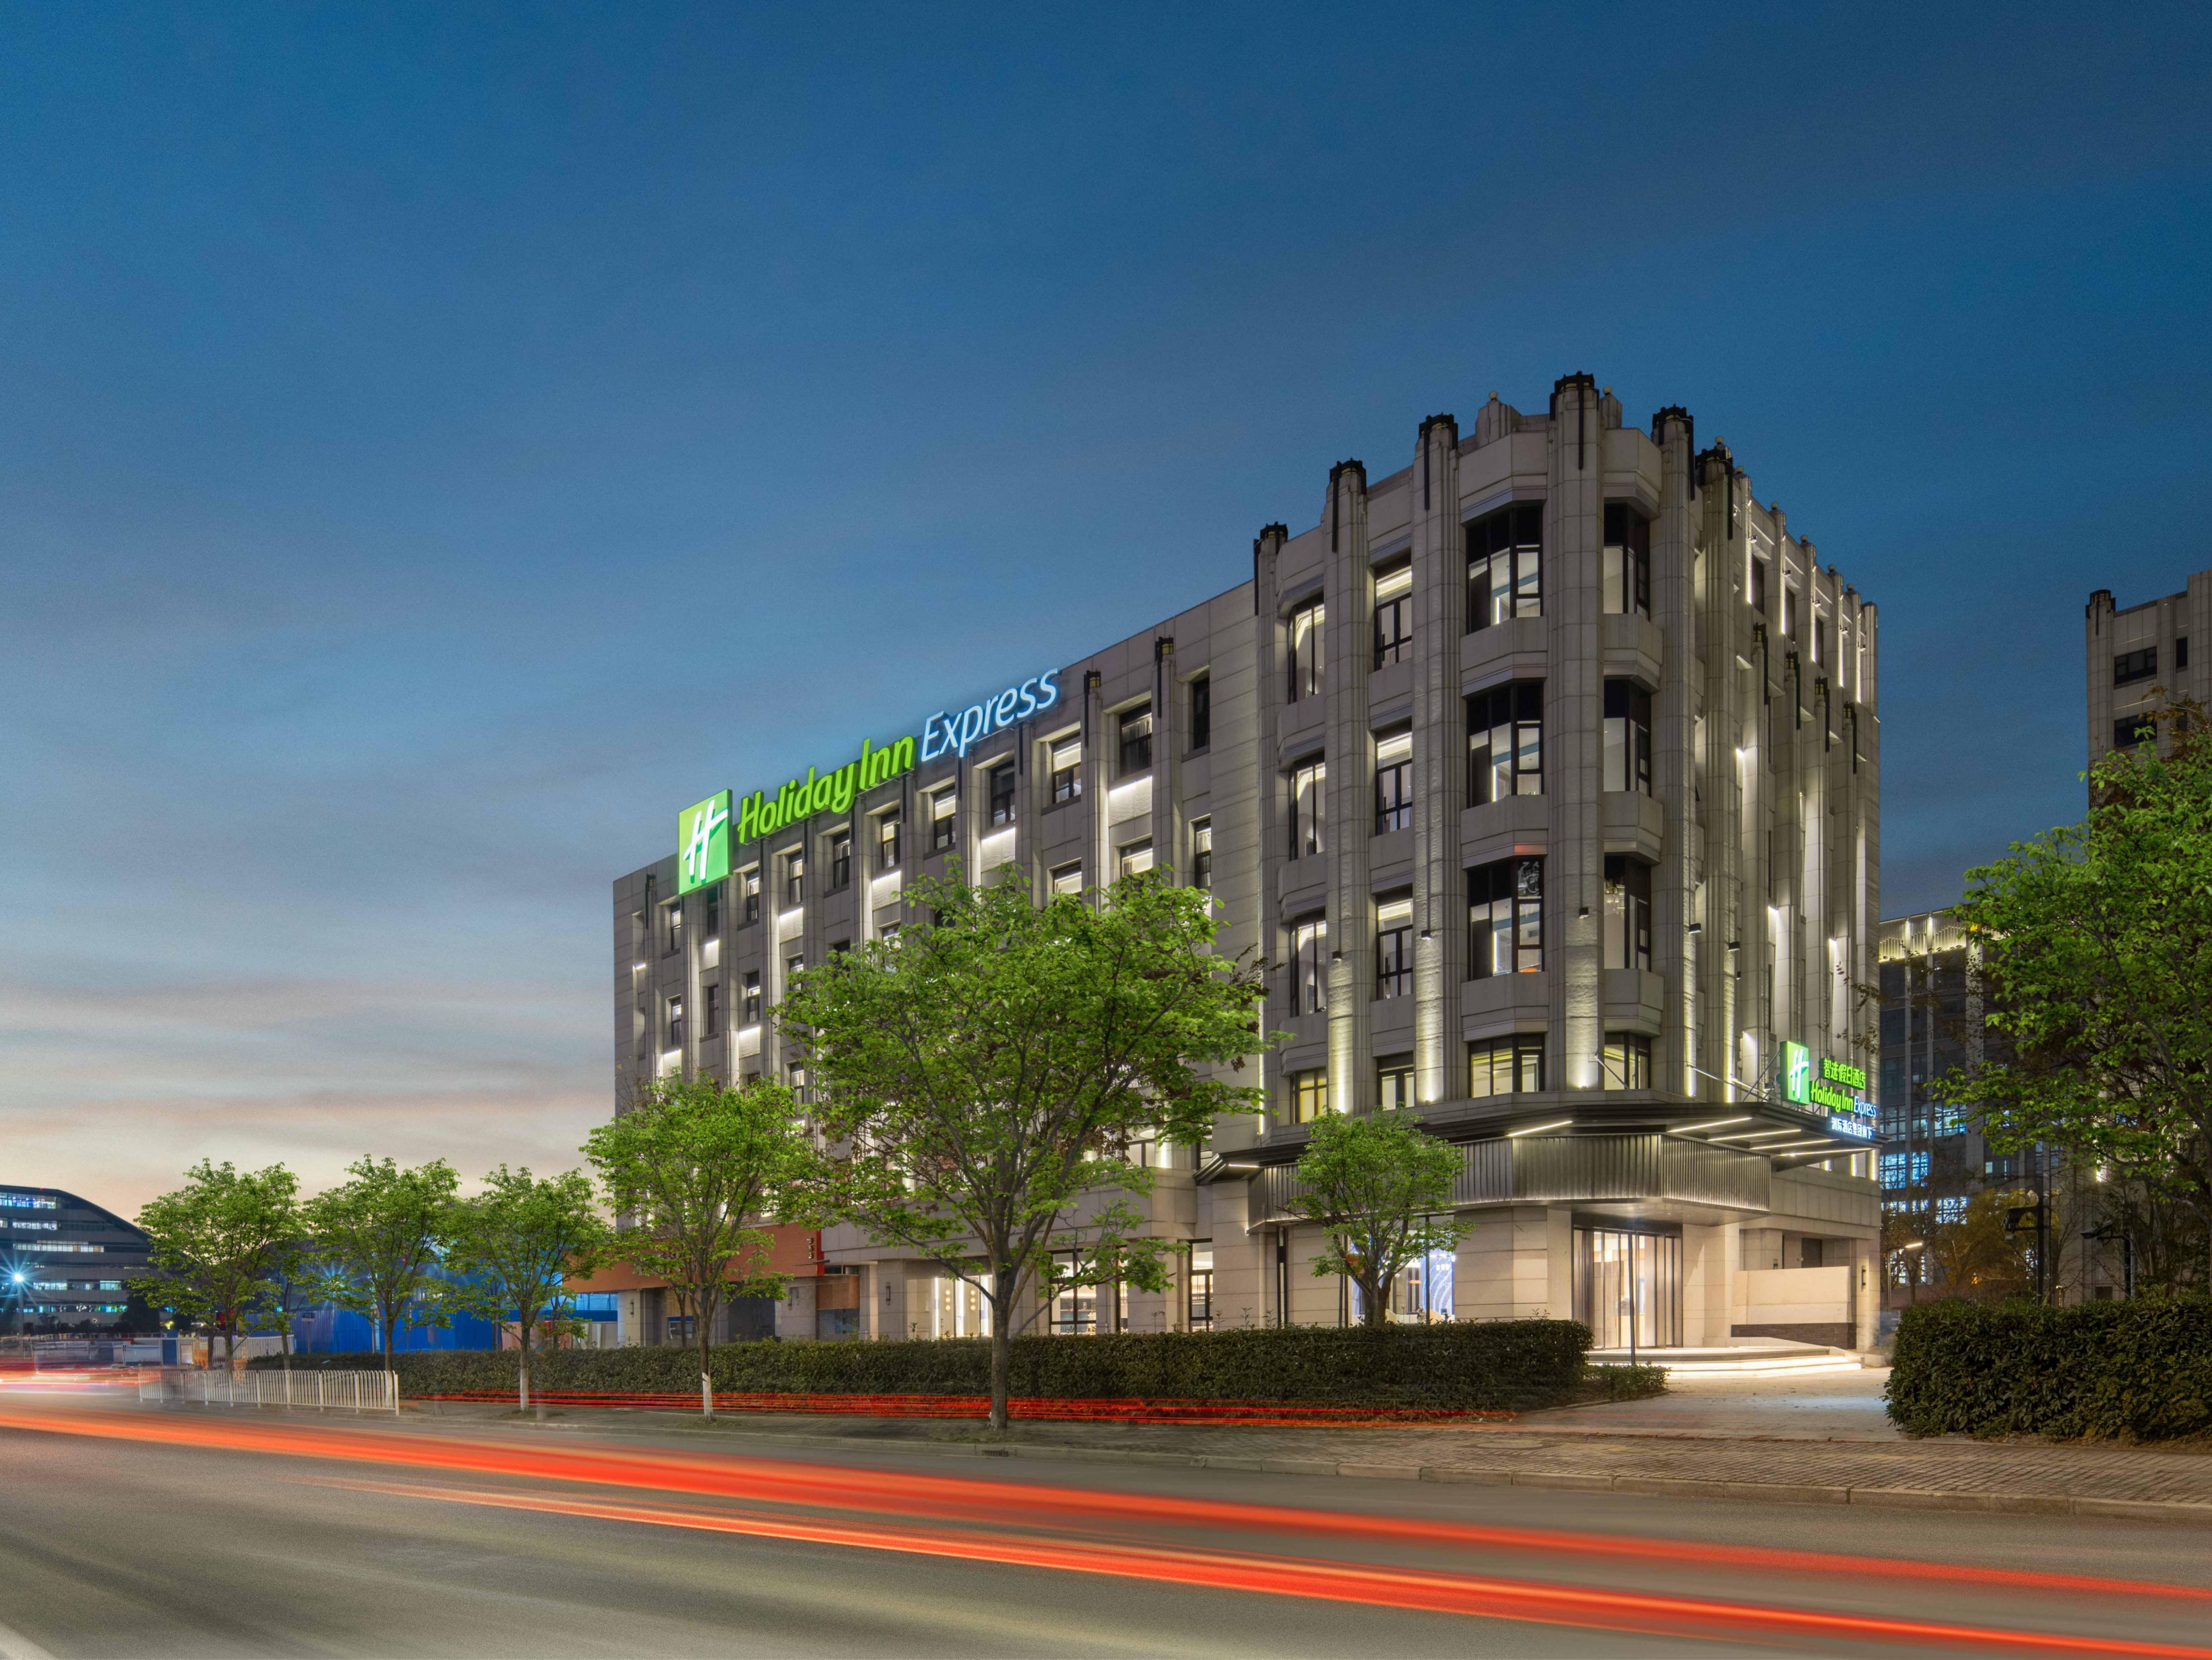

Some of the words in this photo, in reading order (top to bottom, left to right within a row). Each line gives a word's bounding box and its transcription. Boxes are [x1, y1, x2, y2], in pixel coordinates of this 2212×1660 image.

[737, 763, 857, 844] Holiday
[859, 736, 915, 790] Inn
[921, 668, 1058, 762] Express
[1823, 1058, 1866, 1089] 智选假日酒店
[1811, 1080, 1841, 1113] Holiday
[1841, 1089, 1854, 1112] Inn
[1854, 1095, 1877, 1118] Express
